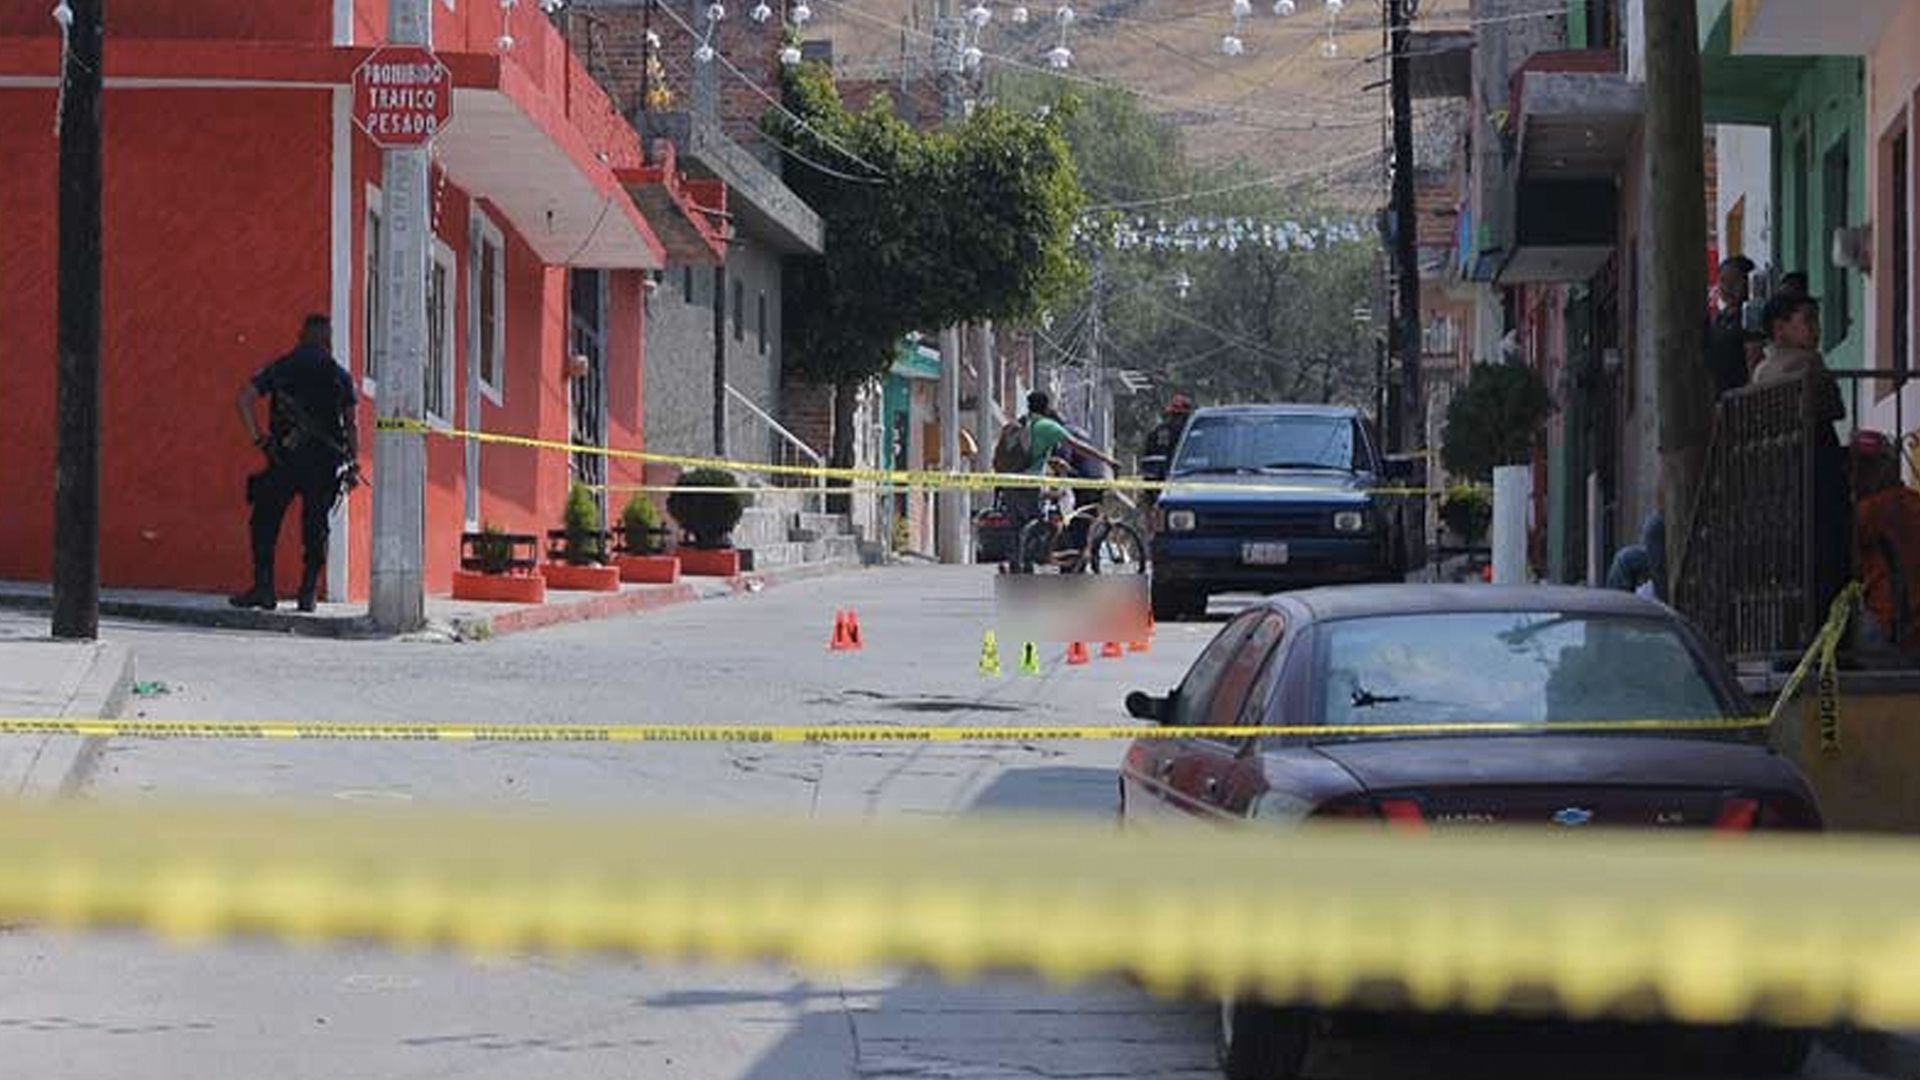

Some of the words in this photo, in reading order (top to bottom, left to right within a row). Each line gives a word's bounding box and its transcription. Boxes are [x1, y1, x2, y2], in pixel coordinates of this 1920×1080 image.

[364, 63, 443, 85] PROHIBIDO
[369, 87, 437, 109] TRAFICO
[367, 111, 438, 135] PESADO
